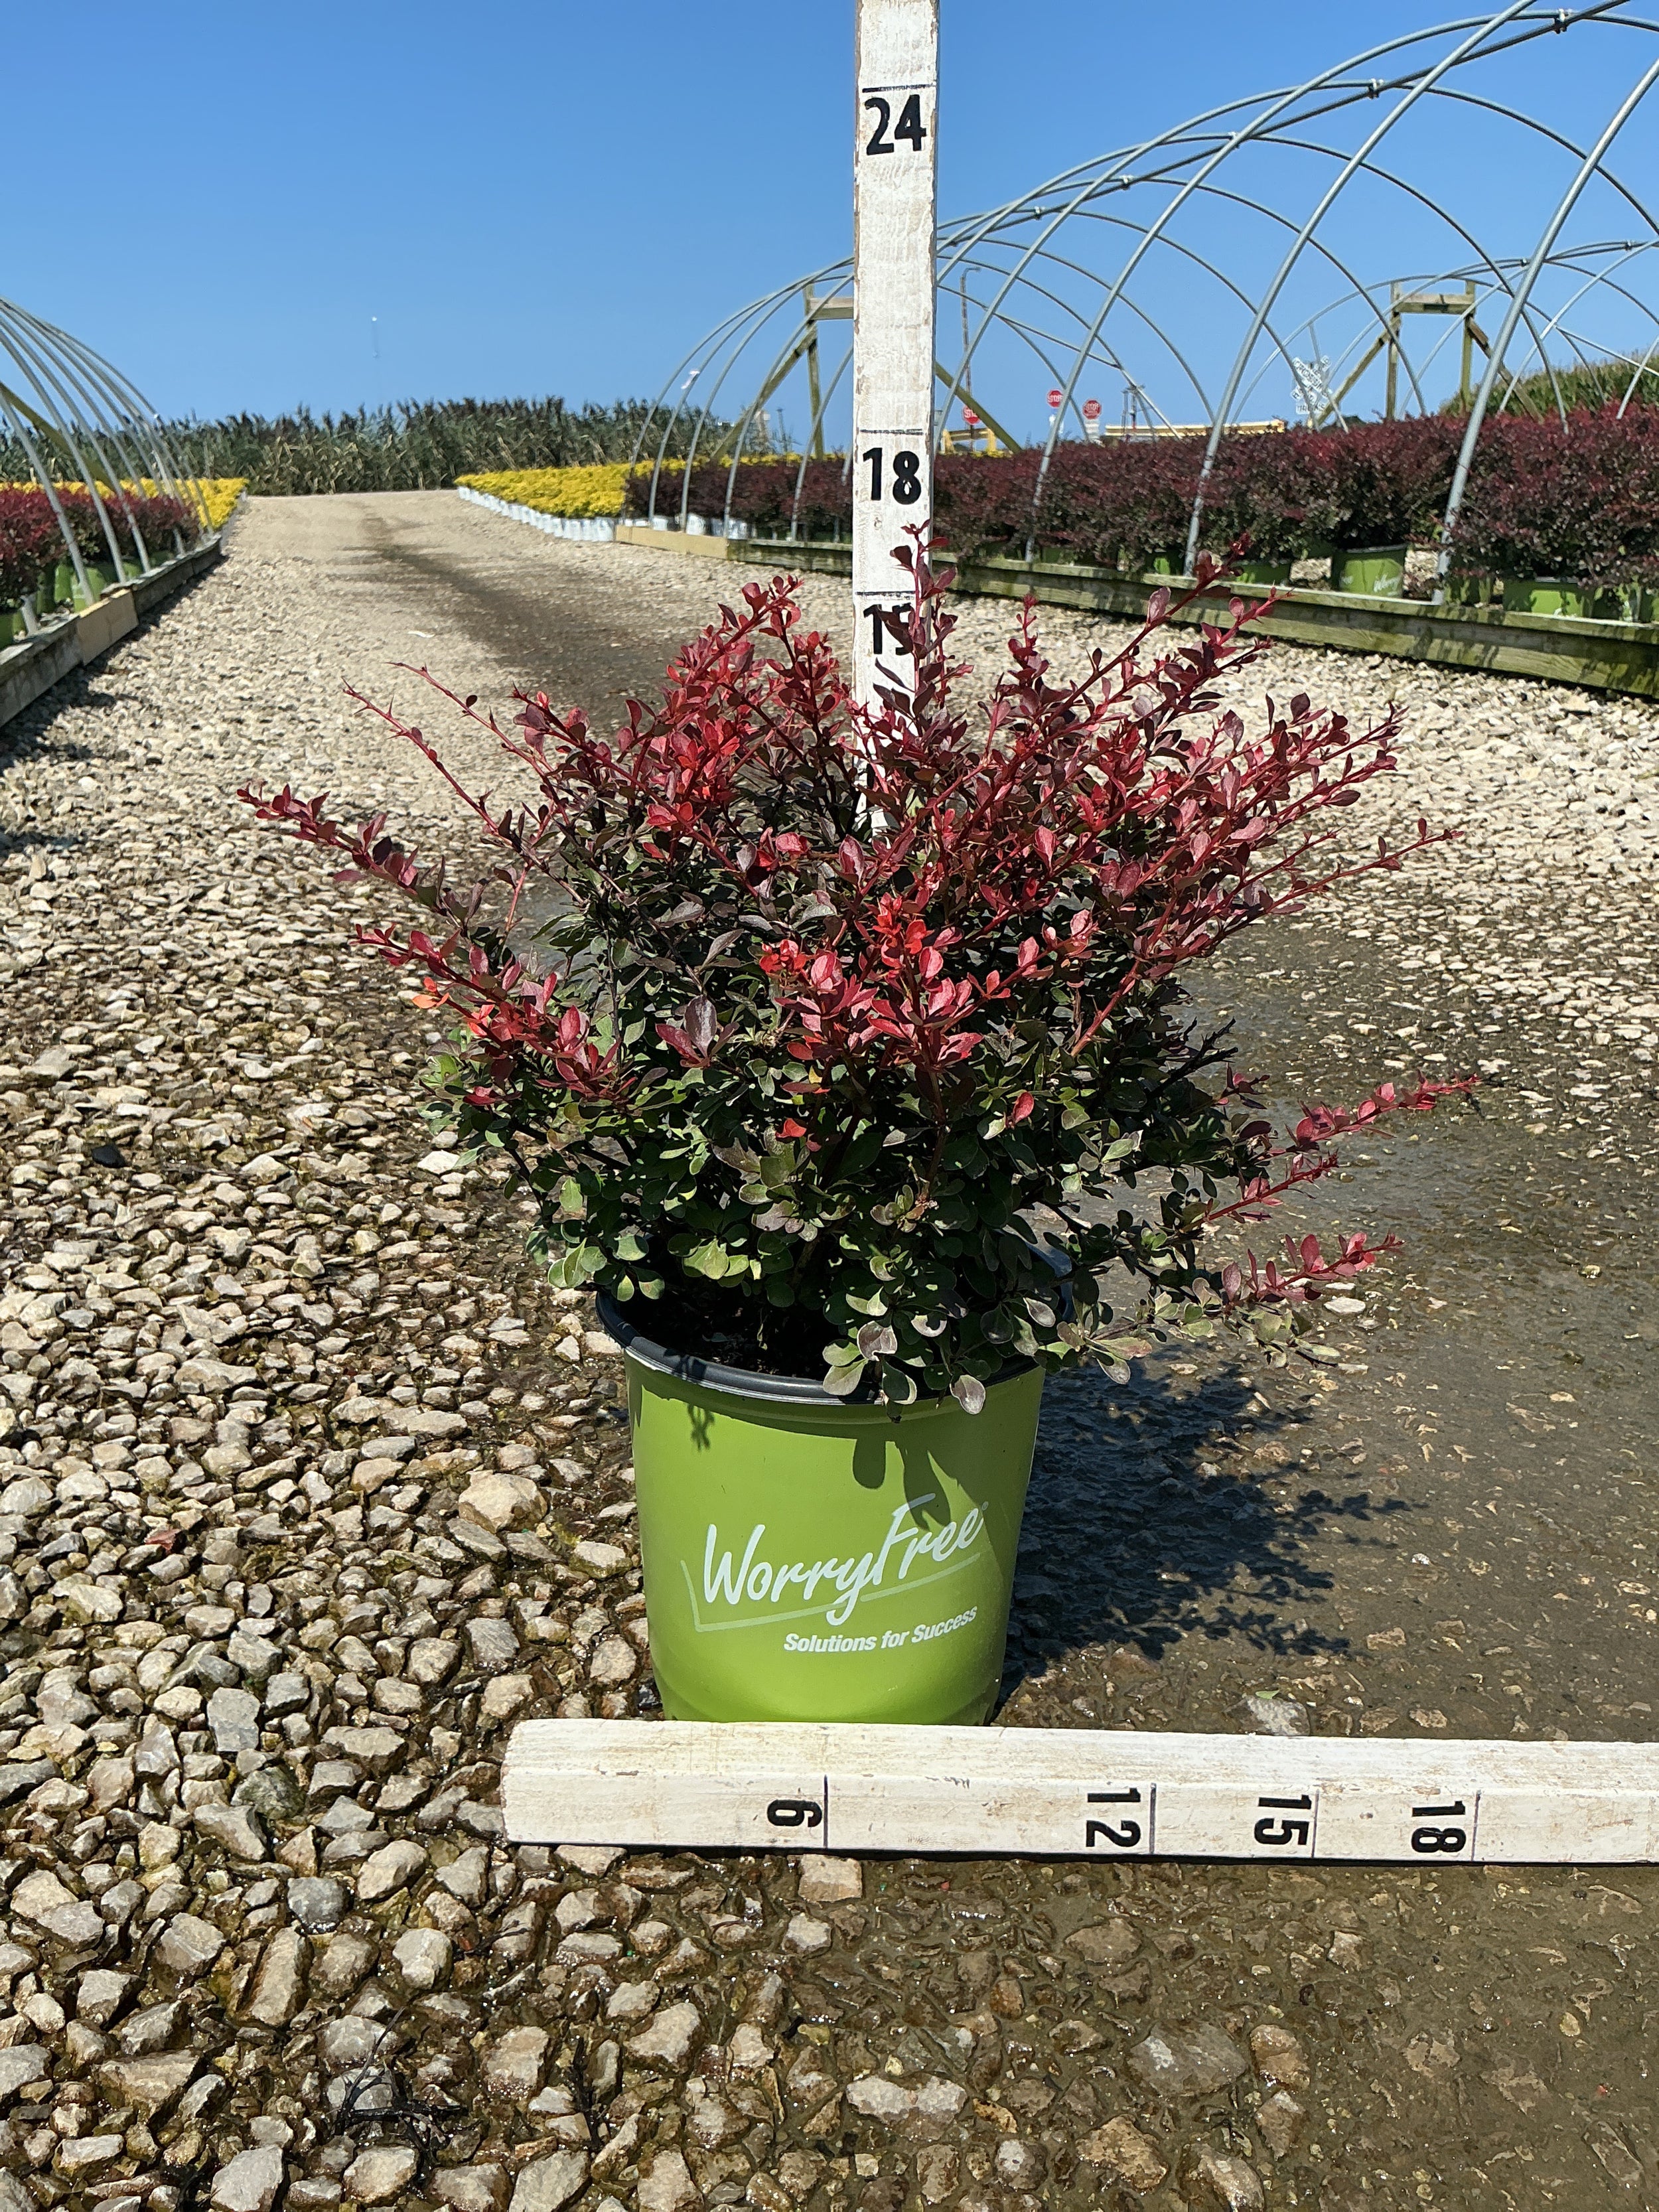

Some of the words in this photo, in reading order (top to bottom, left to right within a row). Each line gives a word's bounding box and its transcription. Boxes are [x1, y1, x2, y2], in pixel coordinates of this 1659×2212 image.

[864, 94, 926, 155] 24
[863, 447, 921, 505] 18
[704, 1493, 984, 1627] WorryFree
[784, 1633, 877, 1653] Solutions
[881, 1629, 910, 1649] for
[912, 1605, 978, 1644] Success
[767, 1799, 822, 1827] 6
[1086, 1787, 1141, 1848] 12
[1255, 1795, 1312, 1846] 15
[1411, 1800, 1467, 1854] 18
